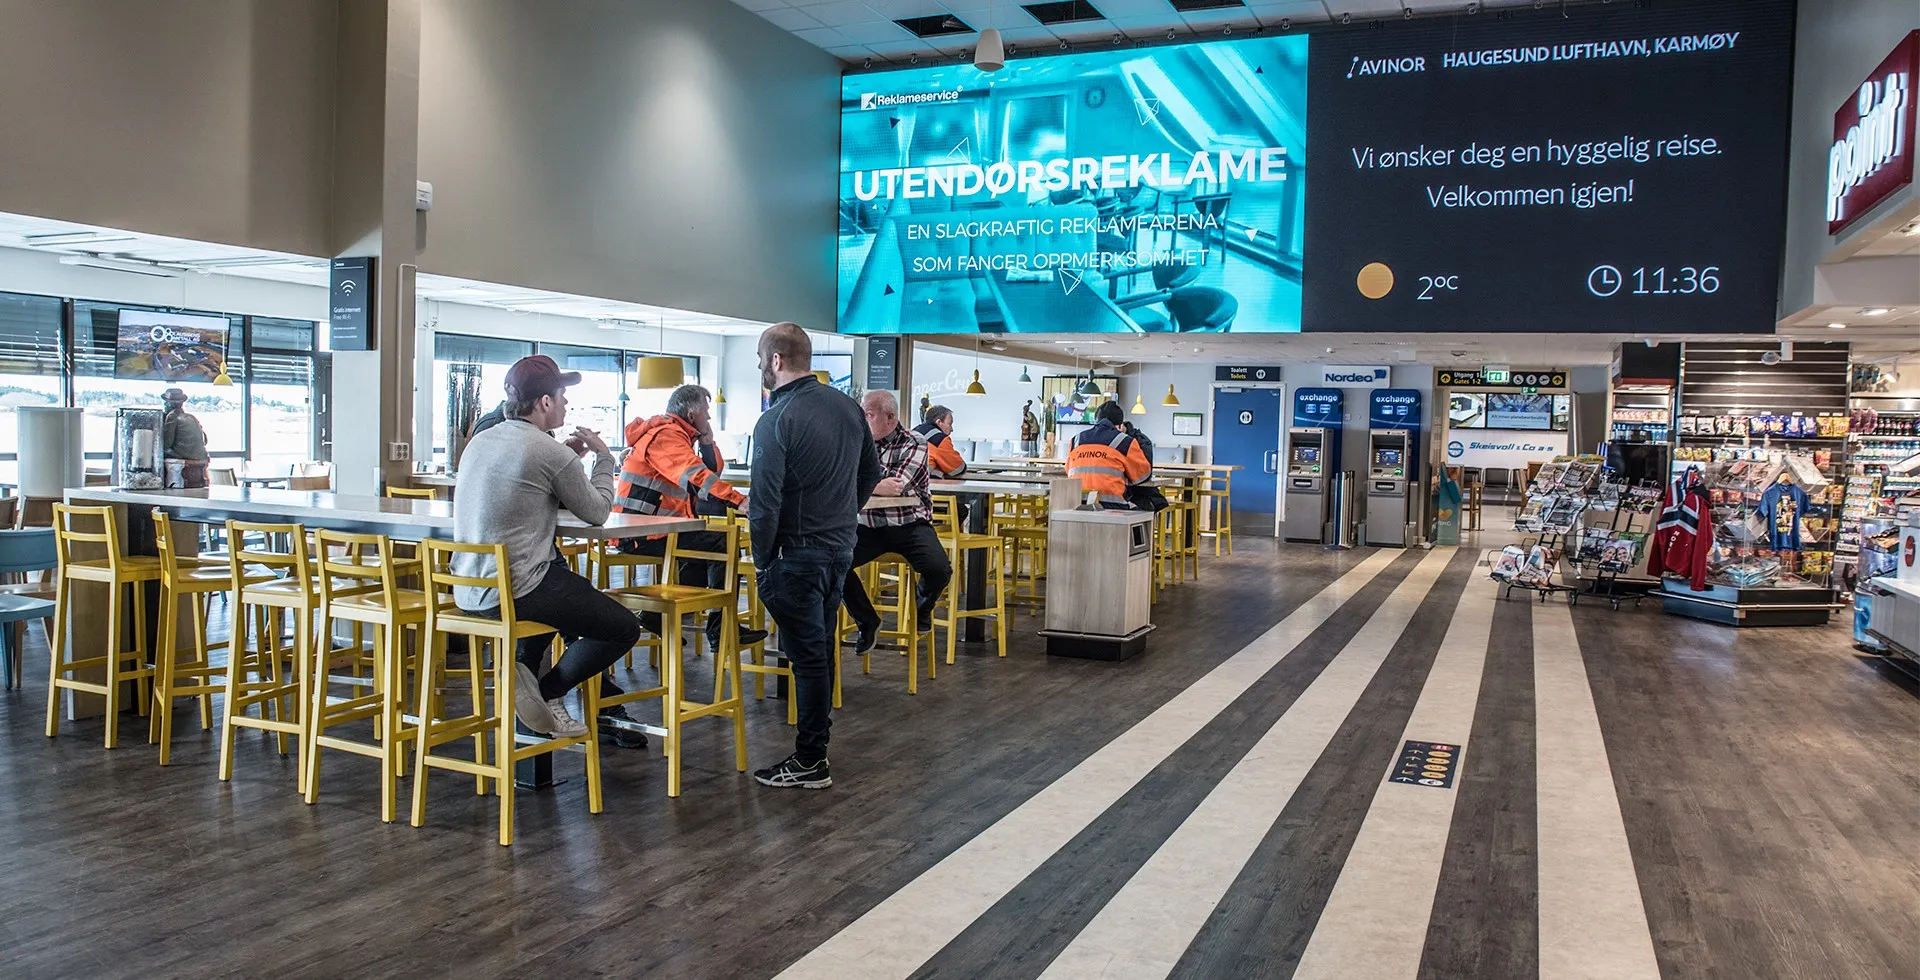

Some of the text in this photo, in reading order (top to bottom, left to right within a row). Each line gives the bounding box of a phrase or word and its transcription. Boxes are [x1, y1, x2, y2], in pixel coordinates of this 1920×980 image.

[1358, 31, 1741, 76] AVINOR HAUGESUND LUFTHAVN, KARMØY
[1351, 134, 1723, 169] Vi ønsker deg en hyggelig reise.
[1826, 72, 1902, 222] point
[854, 146, 1289, 201] UTENDØRSREKLAME
[1426, 179, 1635, 209] Velkommen igjen!
[907, 213, 1219, 240] EN SLAGKRAFTIG REKLAMEARENA
[912, 249, 1209, 273] SOM FANGER OPPMERKSOMHET
[1632, 266, 1721, 295] 11:36
[1325, 372, 1373, 382] Nordea
[1299, 393, 1338, 402] exchange
[1375, 395, 1416, 403] exchange
[1078, 450, 1108, 459] AVINOR
[1469, 441, 1516, 451] Skeisvoll
[1522, 443, 1536, 451] Co
